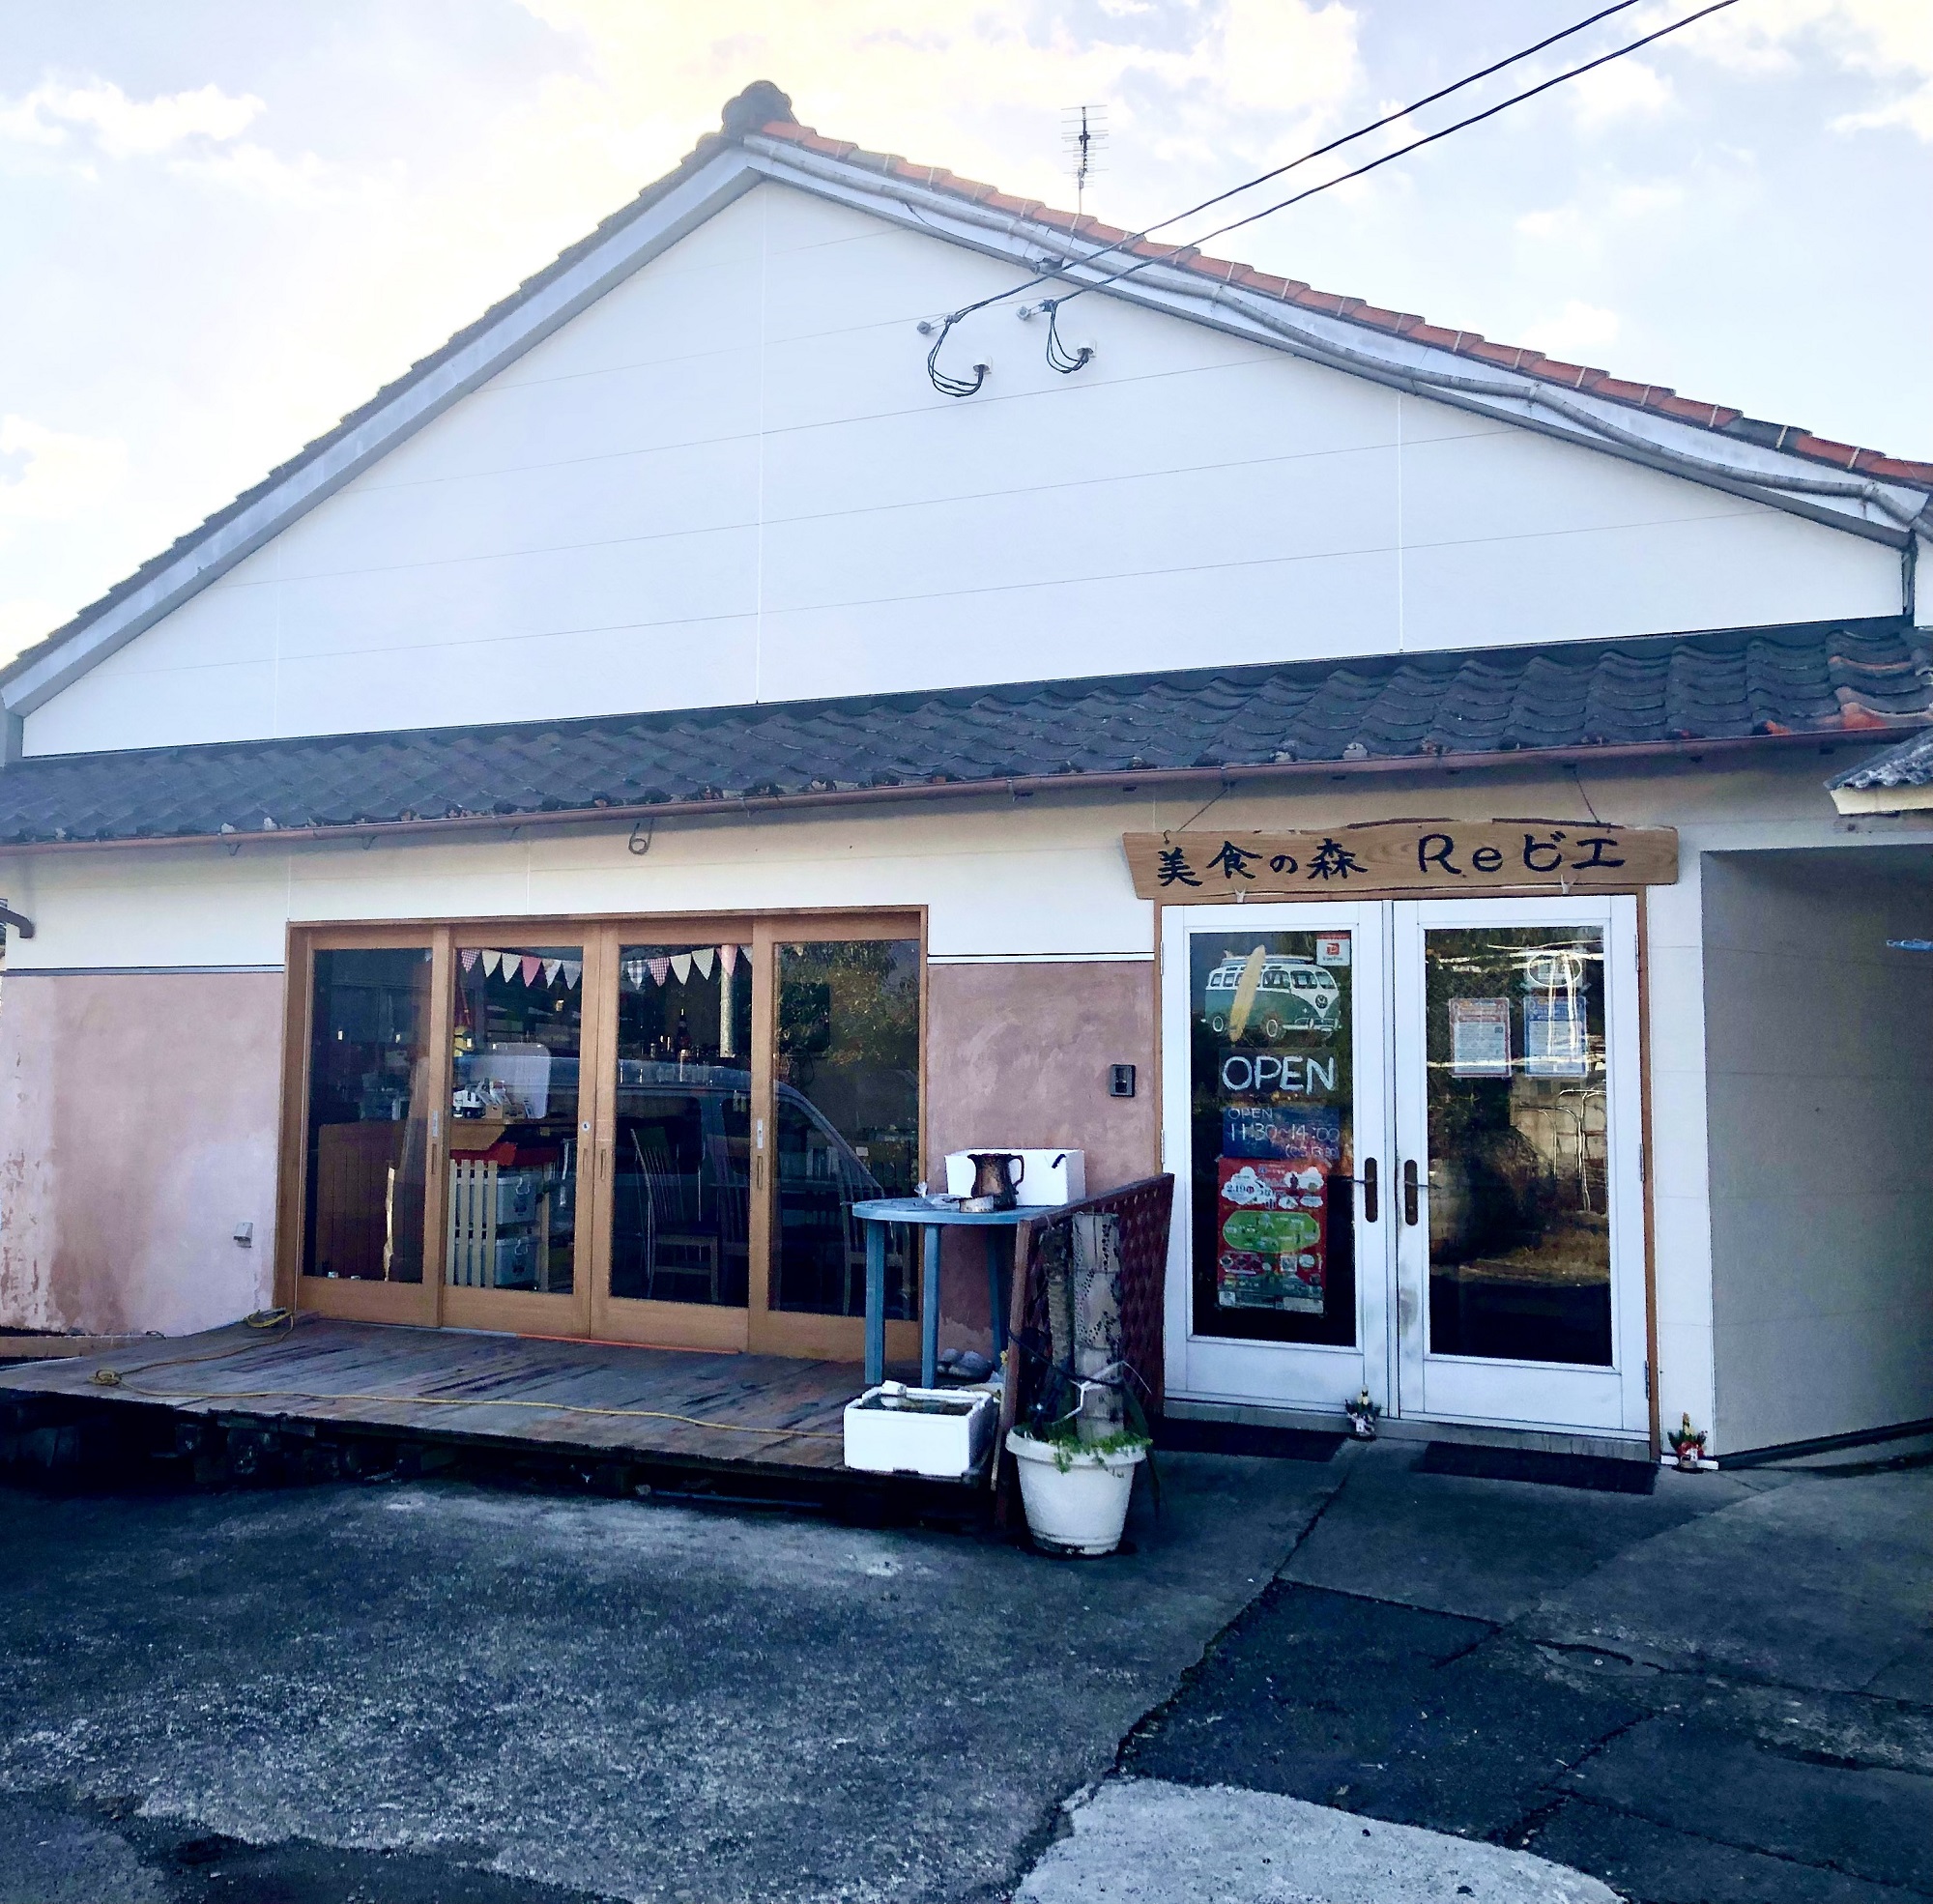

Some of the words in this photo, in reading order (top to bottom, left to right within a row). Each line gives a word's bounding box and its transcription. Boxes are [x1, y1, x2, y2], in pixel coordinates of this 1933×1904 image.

[1159, 837, 1368, 887] 美食の森
[1418, 830, 1626, 876] Reビエ
[1222, 1055, 1335, 1095] OPEN
[1228, 1107, 1273, 1120] OPEN
